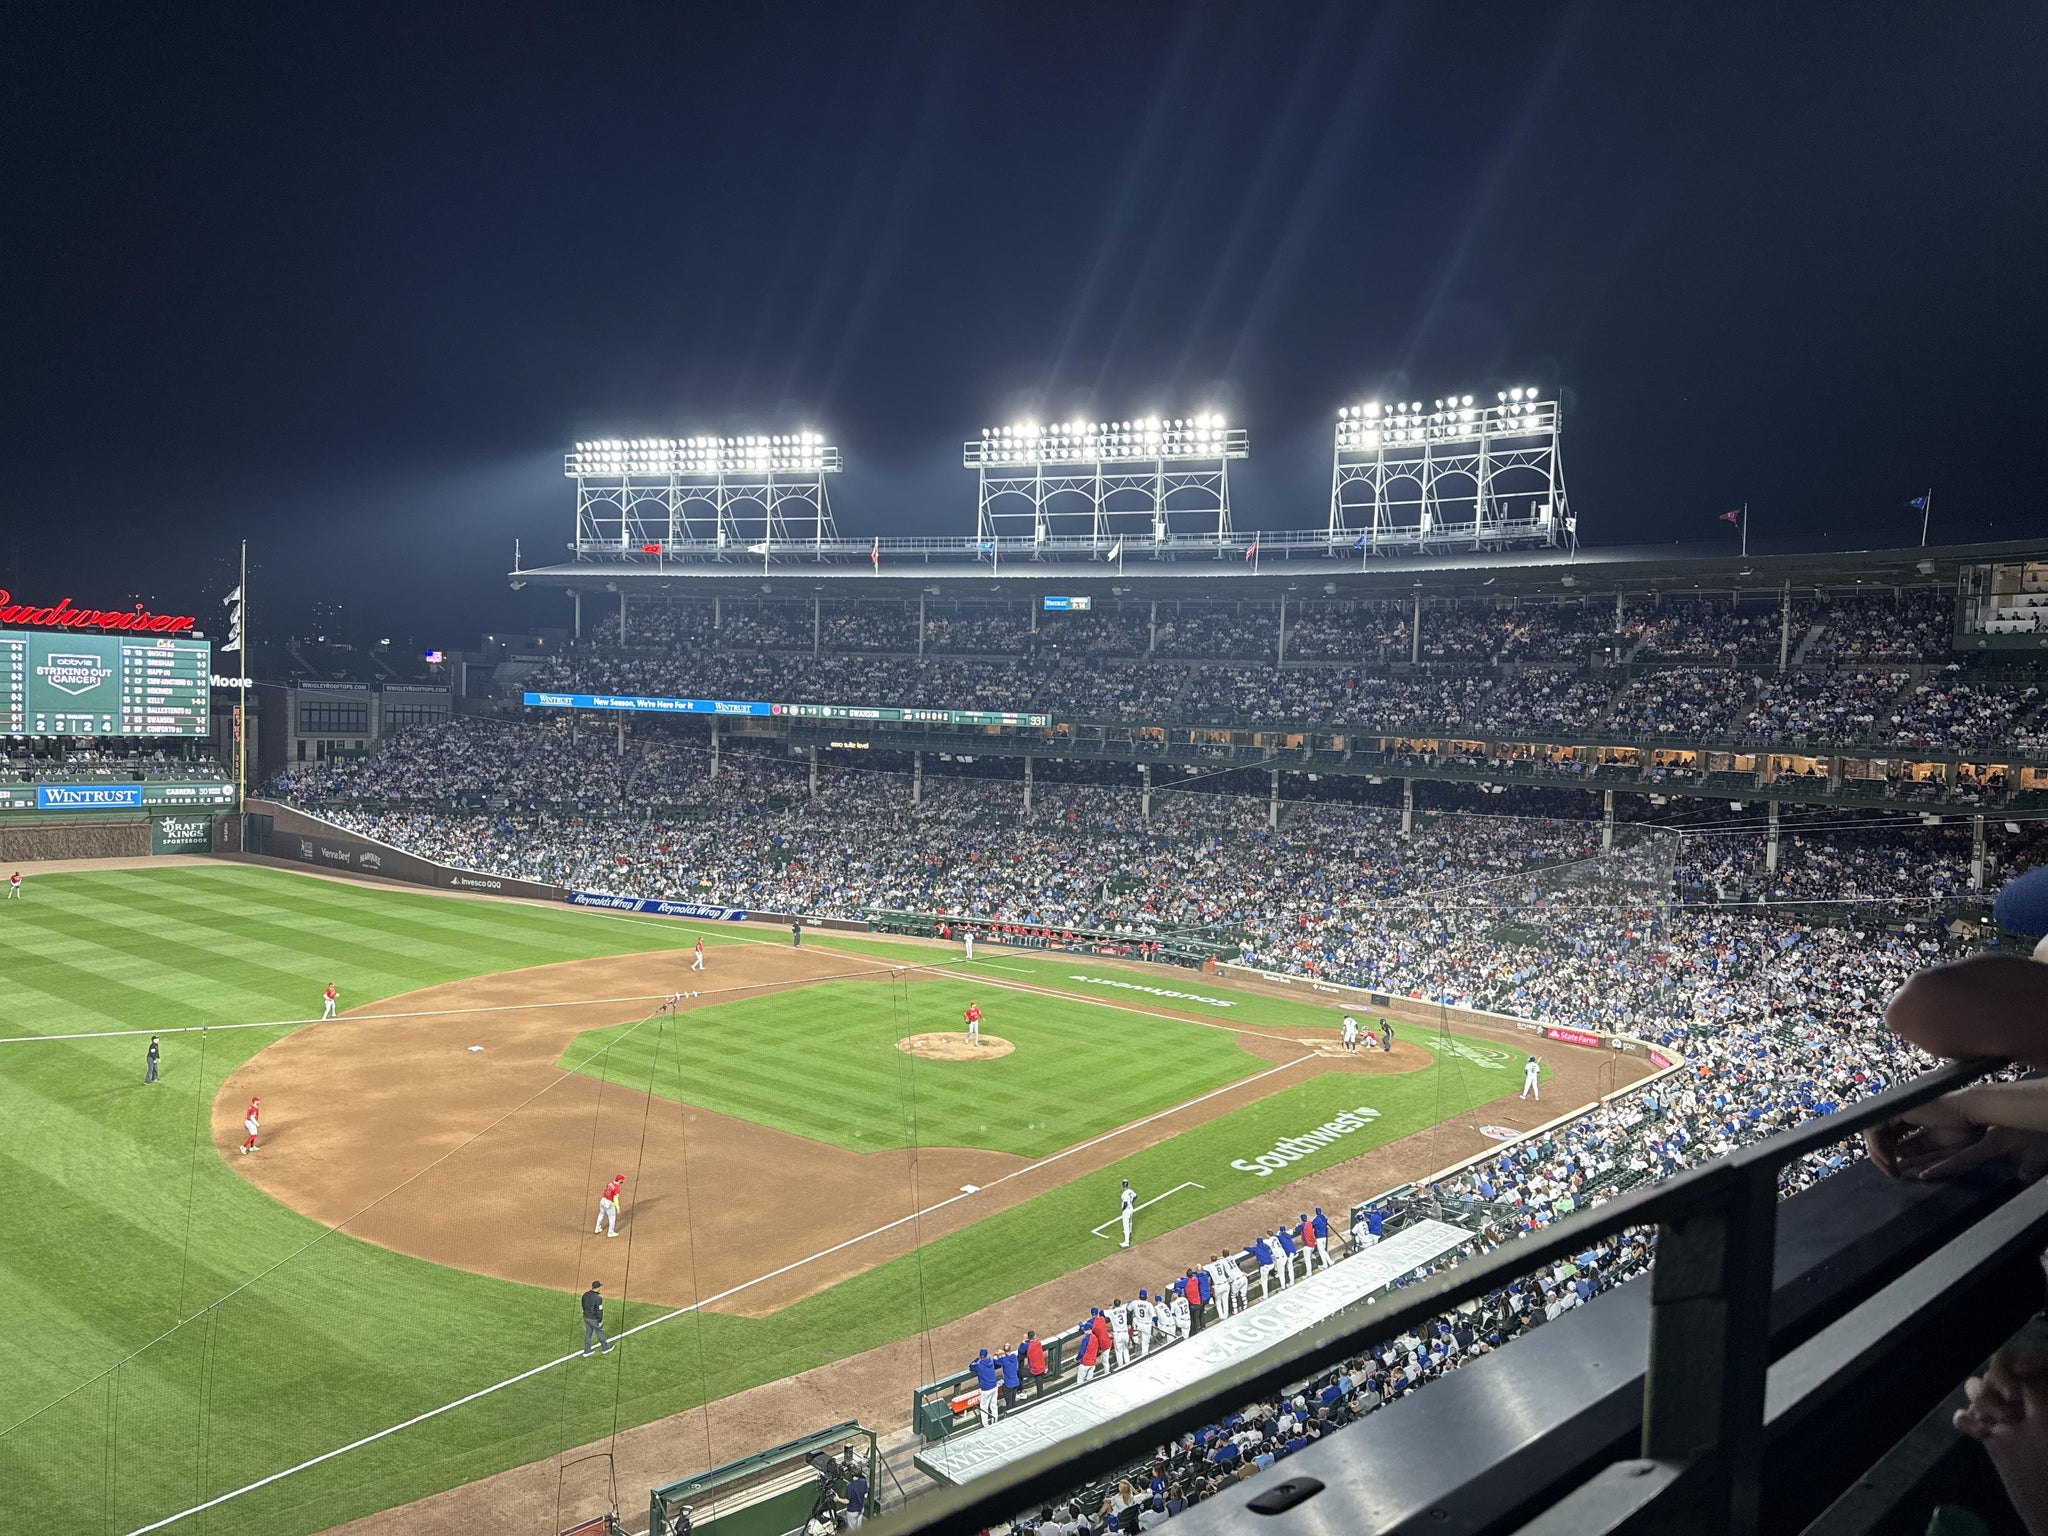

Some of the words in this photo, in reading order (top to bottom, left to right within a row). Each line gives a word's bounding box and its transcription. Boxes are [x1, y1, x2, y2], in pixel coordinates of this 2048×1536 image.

[36, 666, 88, 676] STRIKING
[90, 668, 112, 677] OUT
[52, 676, 97, 684] CANCER
[302, 682, 367, 690] WRIGLEYROOFTOPS.COM
[386, 685, 448, 694] WRIGLEYROOFTOPS.COM
[539, 695, 574, 704] WINTRUST
[594, 698, 610, 706] New
[610, 698, 636, 708] Season,
[637, 699, 656, 708] We're
[657, 700, 674, 709] Here
[674, 701, 688, 710] For
[688, 702, 694, 710] It
[715, 702, 752, 712] WINTRUST
[849, 710, 880, 718] SWANSON
[36, 721, 45, 731] 2
[56, 722, 64, 731] 2
[83, 722, 92, 732] 2
[102, 722, 111, 732] 4
[45, 788, 138, 802] WINTRUST
[163, 822, 205, 832] DRAFT
[321, 848, 338, 860] Vienna
[338, 850, 350, 864] Beef
[360, 852, 380, 866] MARQUEE
[462, 878, 486, 887] Invesco
[487, 880, 502, 889] QQQ
[574, 894, 610, 906] Reynolds
[610, 898, 634, 910] Wrap
[658, 902, 696, 914] Reynolds
[696, 906, 722, 918] Wrap
[1087, 978, 1238, 1007] Southwest
[1560, 1032, 1579, 1041] State
[1579, 1034, 1597, 1046] Farm
[1230, 1110, 1374, 1176] Southwest
[1216, 1267, 1223, 1276] 8
[1138, 1308, 1146, 1318] 9
[1164, 1308, 1171, 1318] 5
[1180, 1304, 1188, 1316] 12
[1118, 1314, 1124, 1324] 3
[938, 1418, 1067, 1472] WINTRUST
